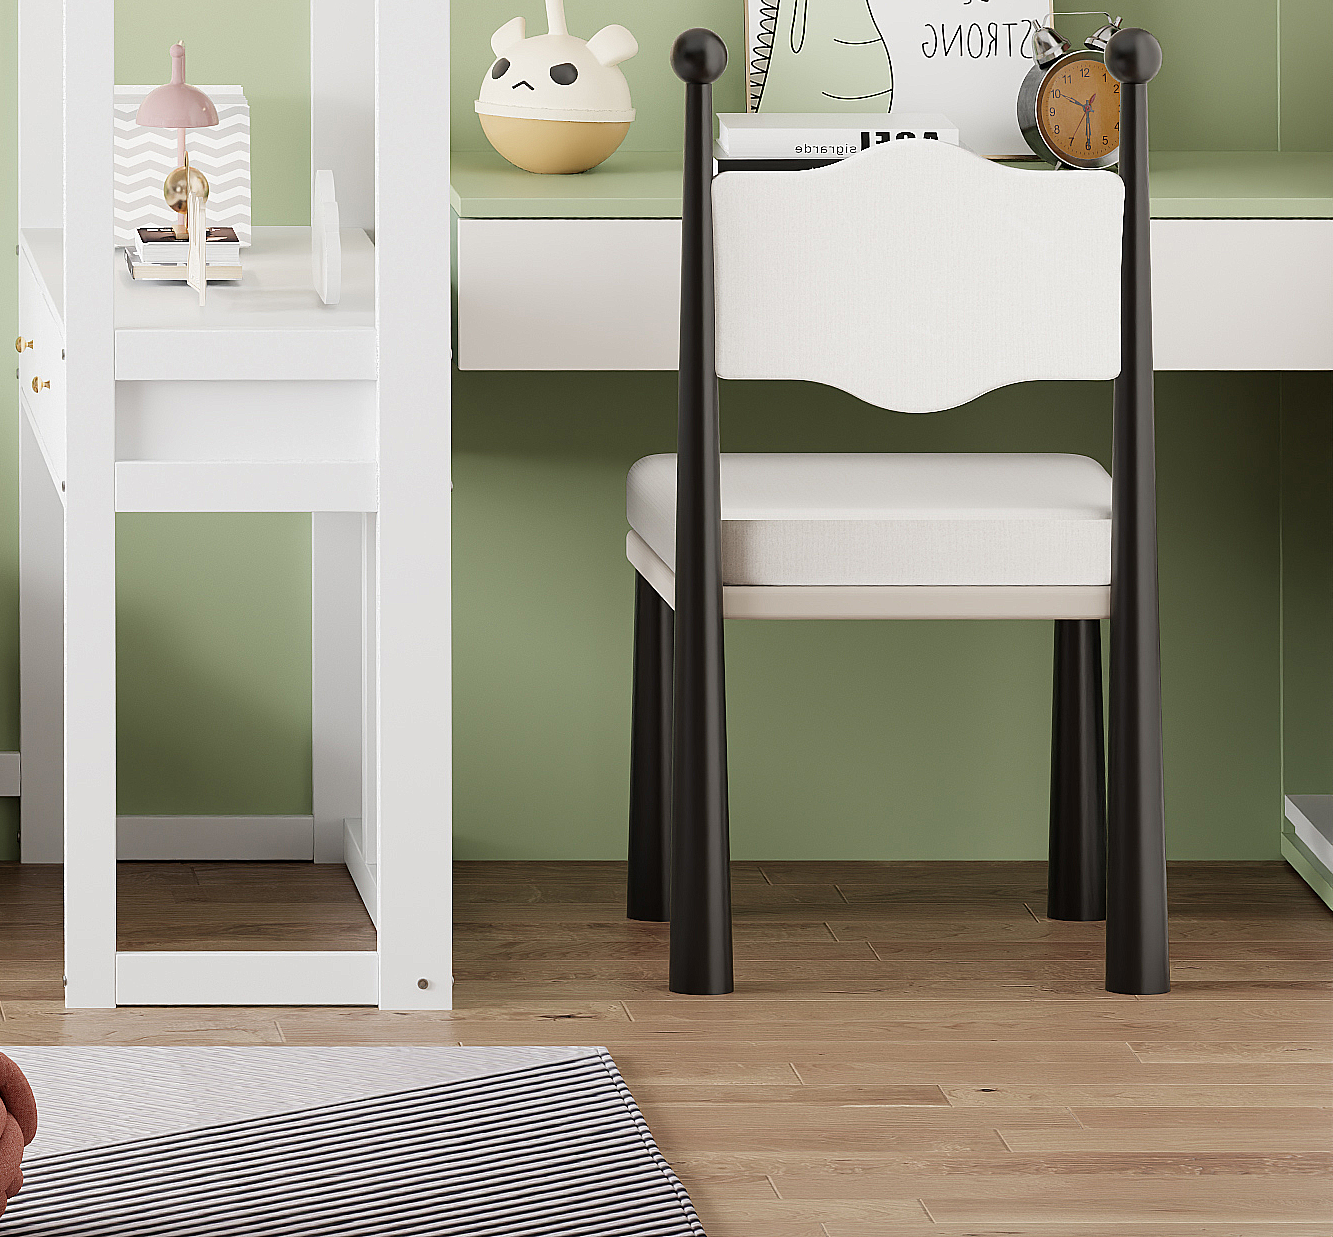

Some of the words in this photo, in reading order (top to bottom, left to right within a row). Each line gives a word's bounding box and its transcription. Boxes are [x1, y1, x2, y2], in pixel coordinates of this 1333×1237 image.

[1079, 67, 1090, 78] 12
[1062, 74, 1072, 84] 11
[1050, 88, 1061, 99] 10
[1113, 84, 1120, 94] 2
[1049, 107, 1056, 117] 9
[1054, 124, 1060, 134] 8
[1068, 137, 1074, 147] 7
[1102, 135, 1109, 145] 5
[1085, 141, 1092, 151] 6
